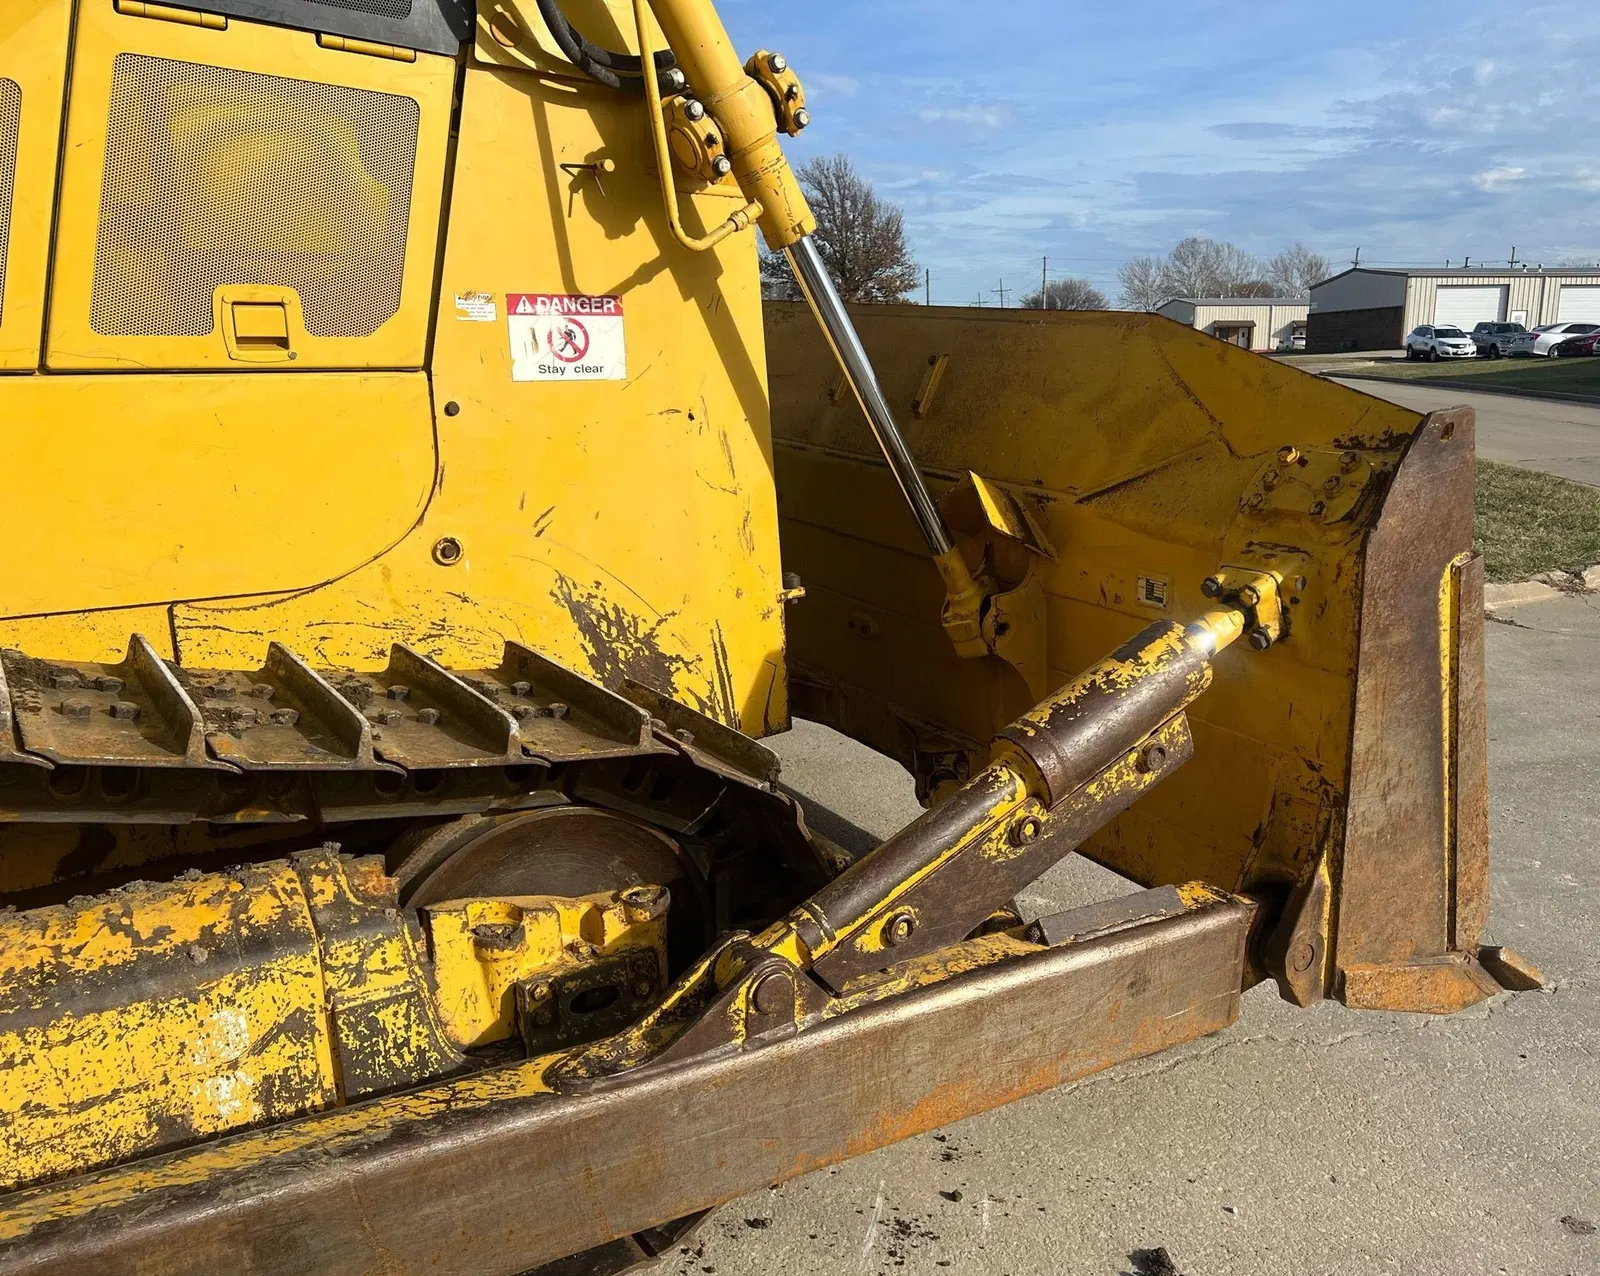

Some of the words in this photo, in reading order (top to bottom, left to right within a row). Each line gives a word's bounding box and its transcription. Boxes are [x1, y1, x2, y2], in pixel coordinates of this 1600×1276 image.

[536, 297, 616, 313] DANGER
[538, 364, 566, 376] Stay
[574, 364, 604, 373] clear
